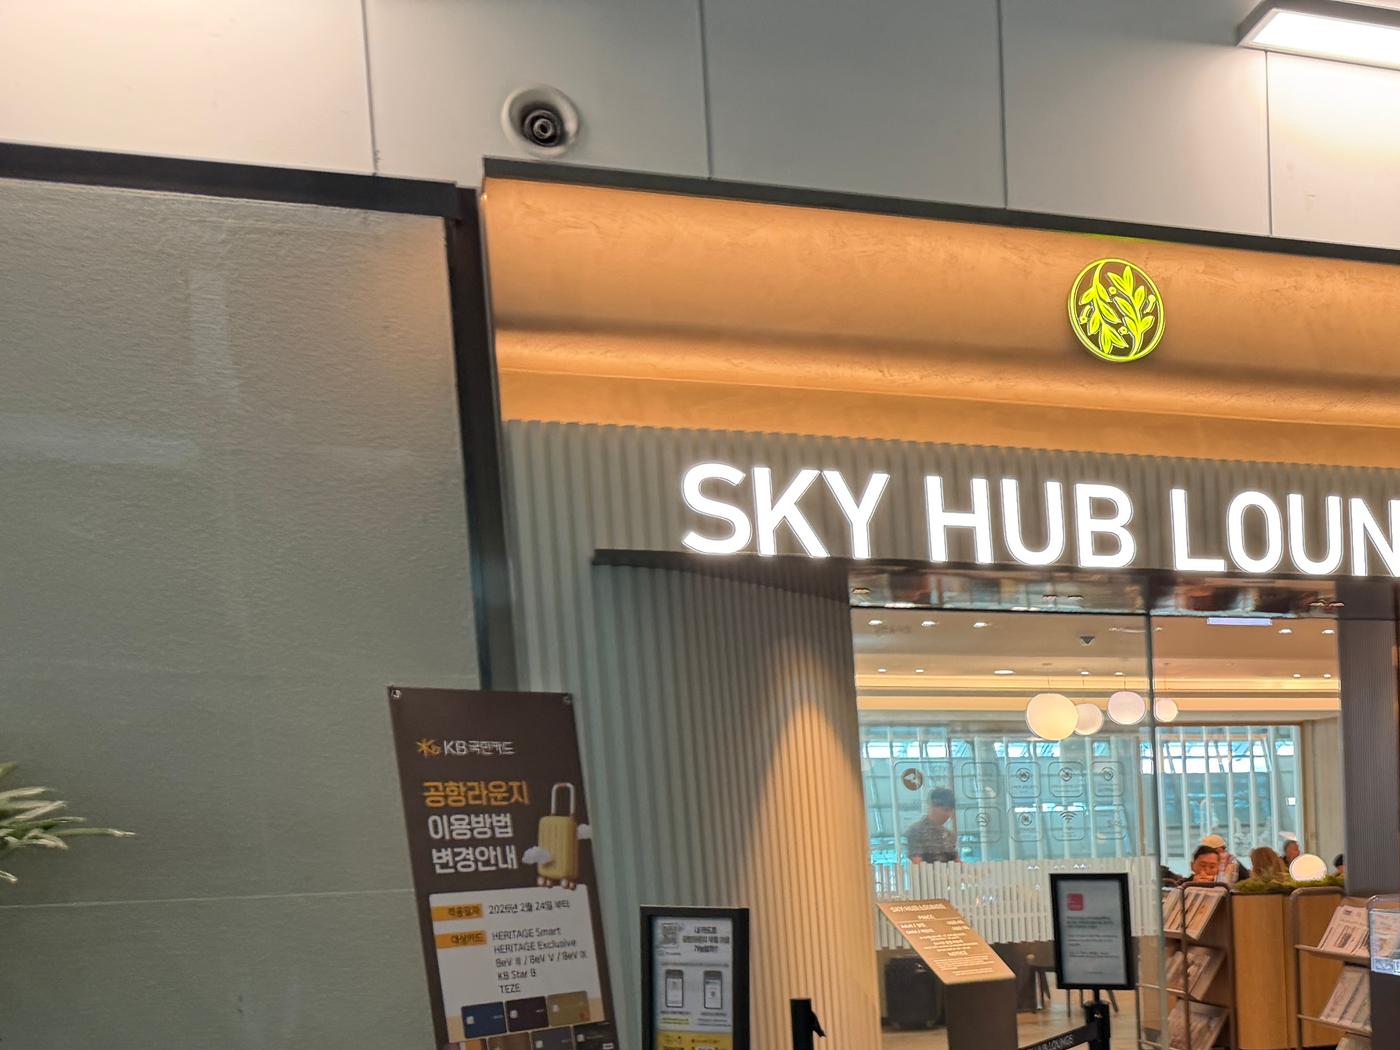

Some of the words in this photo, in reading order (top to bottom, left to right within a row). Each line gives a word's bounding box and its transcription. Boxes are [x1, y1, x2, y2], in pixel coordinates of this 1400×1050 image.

[680, 462, 890, 559] SKY
[926, 474, 1137, 568] HUB
[421, 780, 532, 809] 공항라운지
[428, 812, 514, 840] 이용방법
[431, 845, 519, 874] 변경안내
[492, 930, 535, 942] HERITAGE
[536, 926, 561, 938] Smart
[494, 942, 536, 954] HERITAGE
[538, 939, 577, 951] Exclusive
